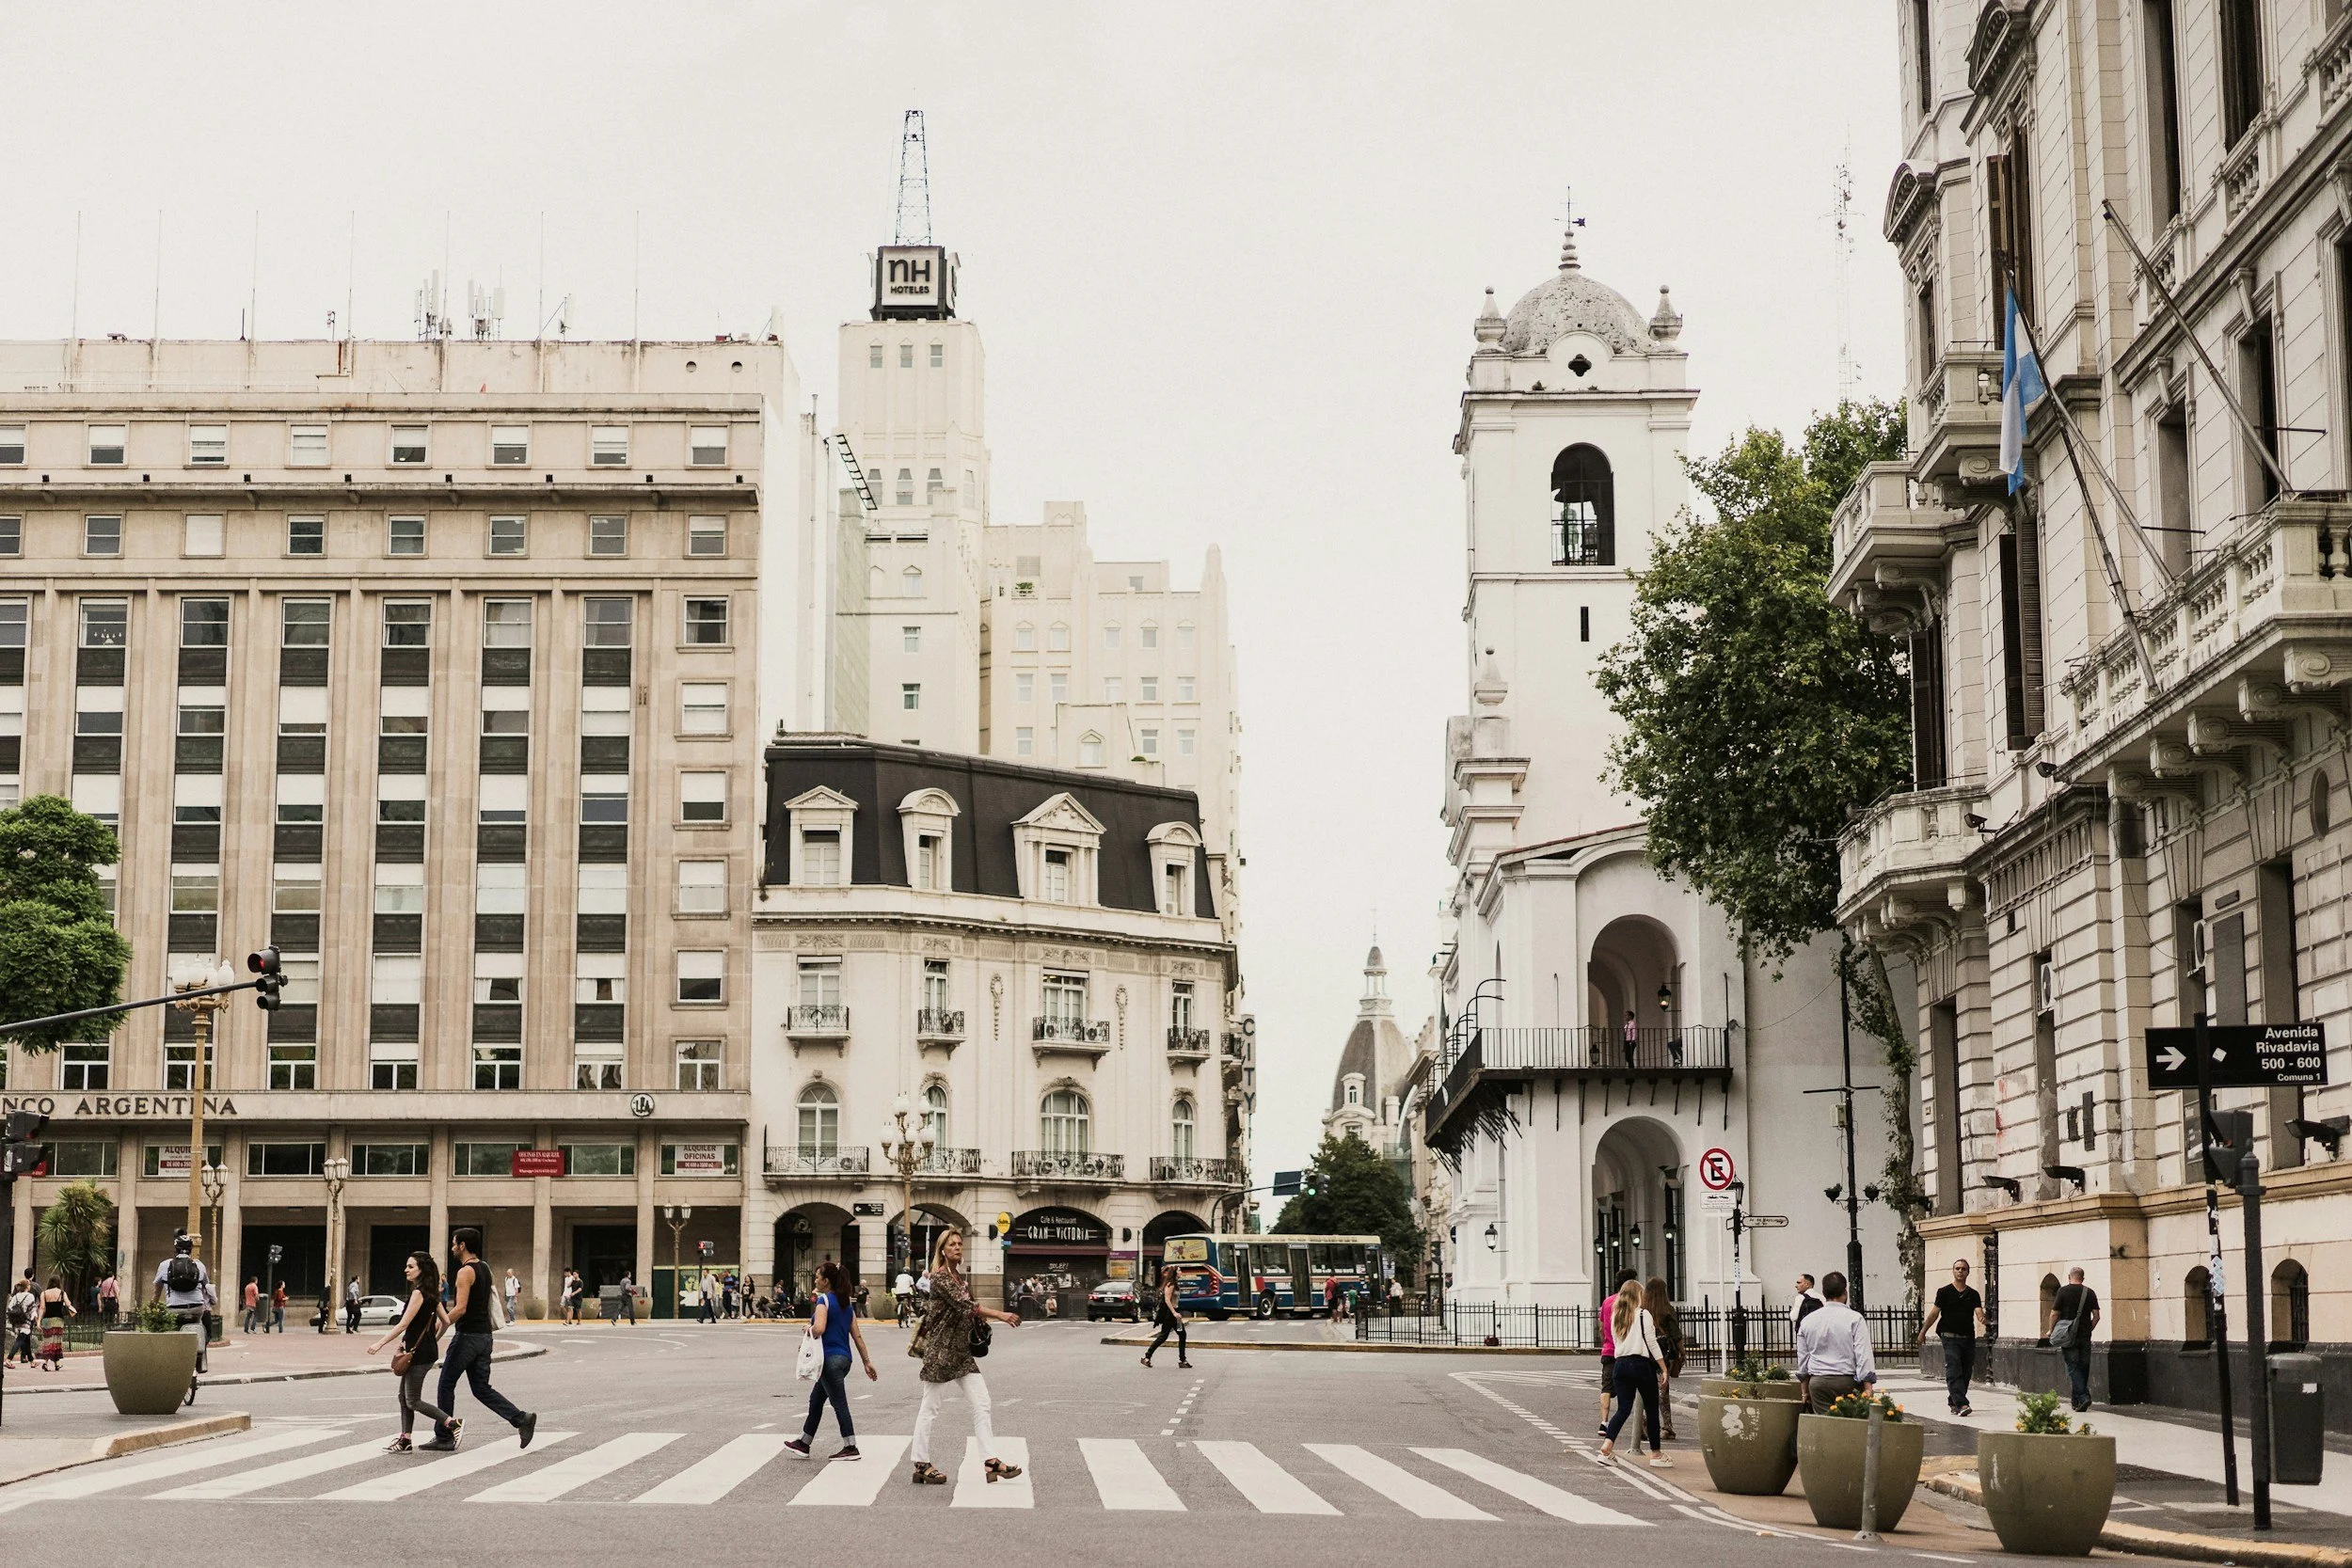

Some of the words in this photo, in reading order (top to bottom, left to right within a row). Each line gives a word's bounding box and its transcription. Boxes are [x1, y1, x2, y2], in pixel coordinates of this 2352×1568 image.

[890, 286, 930, 294] HOTELES
[2265, 1026, 2319, 1038] Avenida
[2256, 1040, 2320, 1053] Rivadavia
[1243, 1018, 1255, 1112] CITY
[2261, 1057, 2285, 1069] 500
[2296, 1056, 2321, 1069] 600
[2277, 1073, 2313, 1082] Comuna
[2315, 1072, 2321, 1081] 1
[74, 1097, 238, 1115] ARGENTINA
[1710, 1157, 1724, 1181] E
[1027, 1226, 1049, 1240] GRAN
